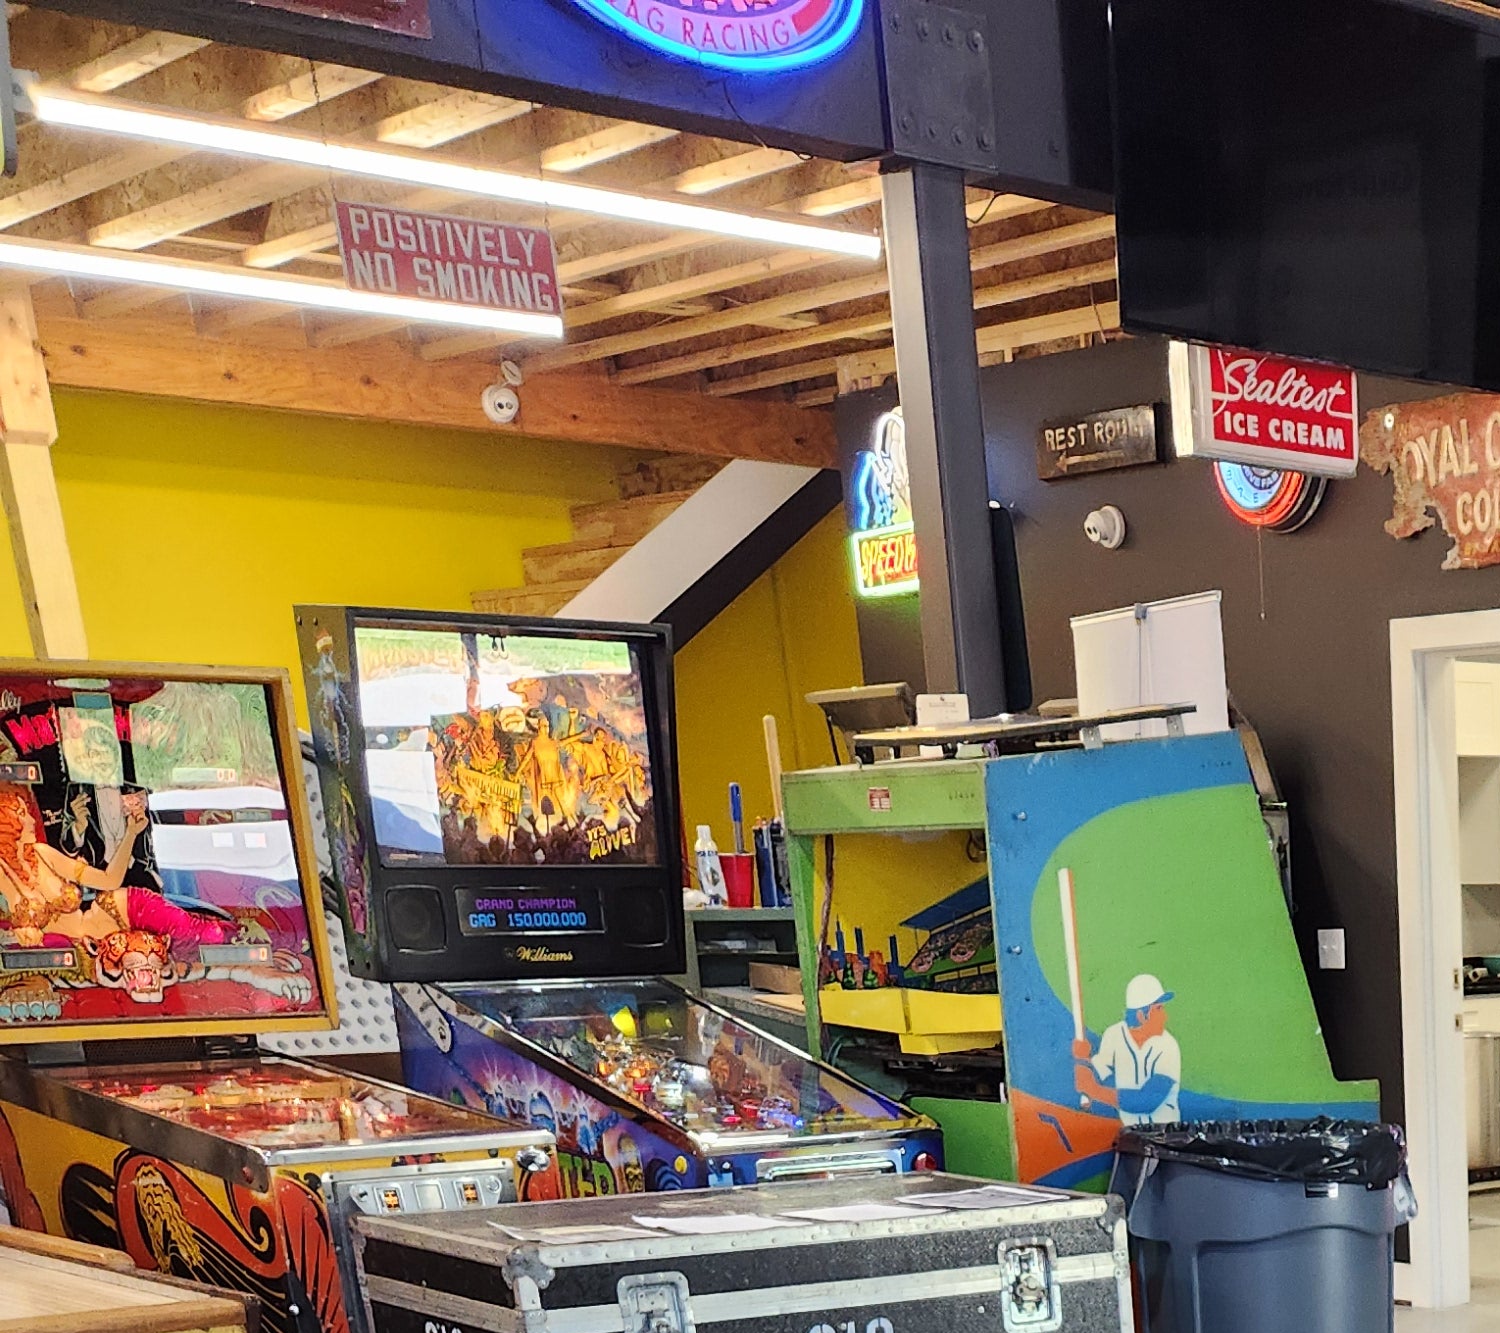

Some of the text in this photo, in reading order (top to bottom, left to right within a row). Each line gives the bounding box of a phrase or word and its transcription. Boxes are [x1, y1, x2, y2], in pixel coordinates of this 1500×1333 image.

[682, 17, 790, 51] RACING
[349, 207, 535, 267] POSITIVELY
[351, 249, 553, 311] NO SMOKING
[1216, 357, 1353, 418] Sealtest
[1045, 422, 1087, 451] REST
[1225, 411, 1346, 451] ICE CREAM
[1400, 418, 1479, 489] OYAL
[476, 899, 576, 910] GRAND CHAMPION
[516, 946, 574, 961] Williams
